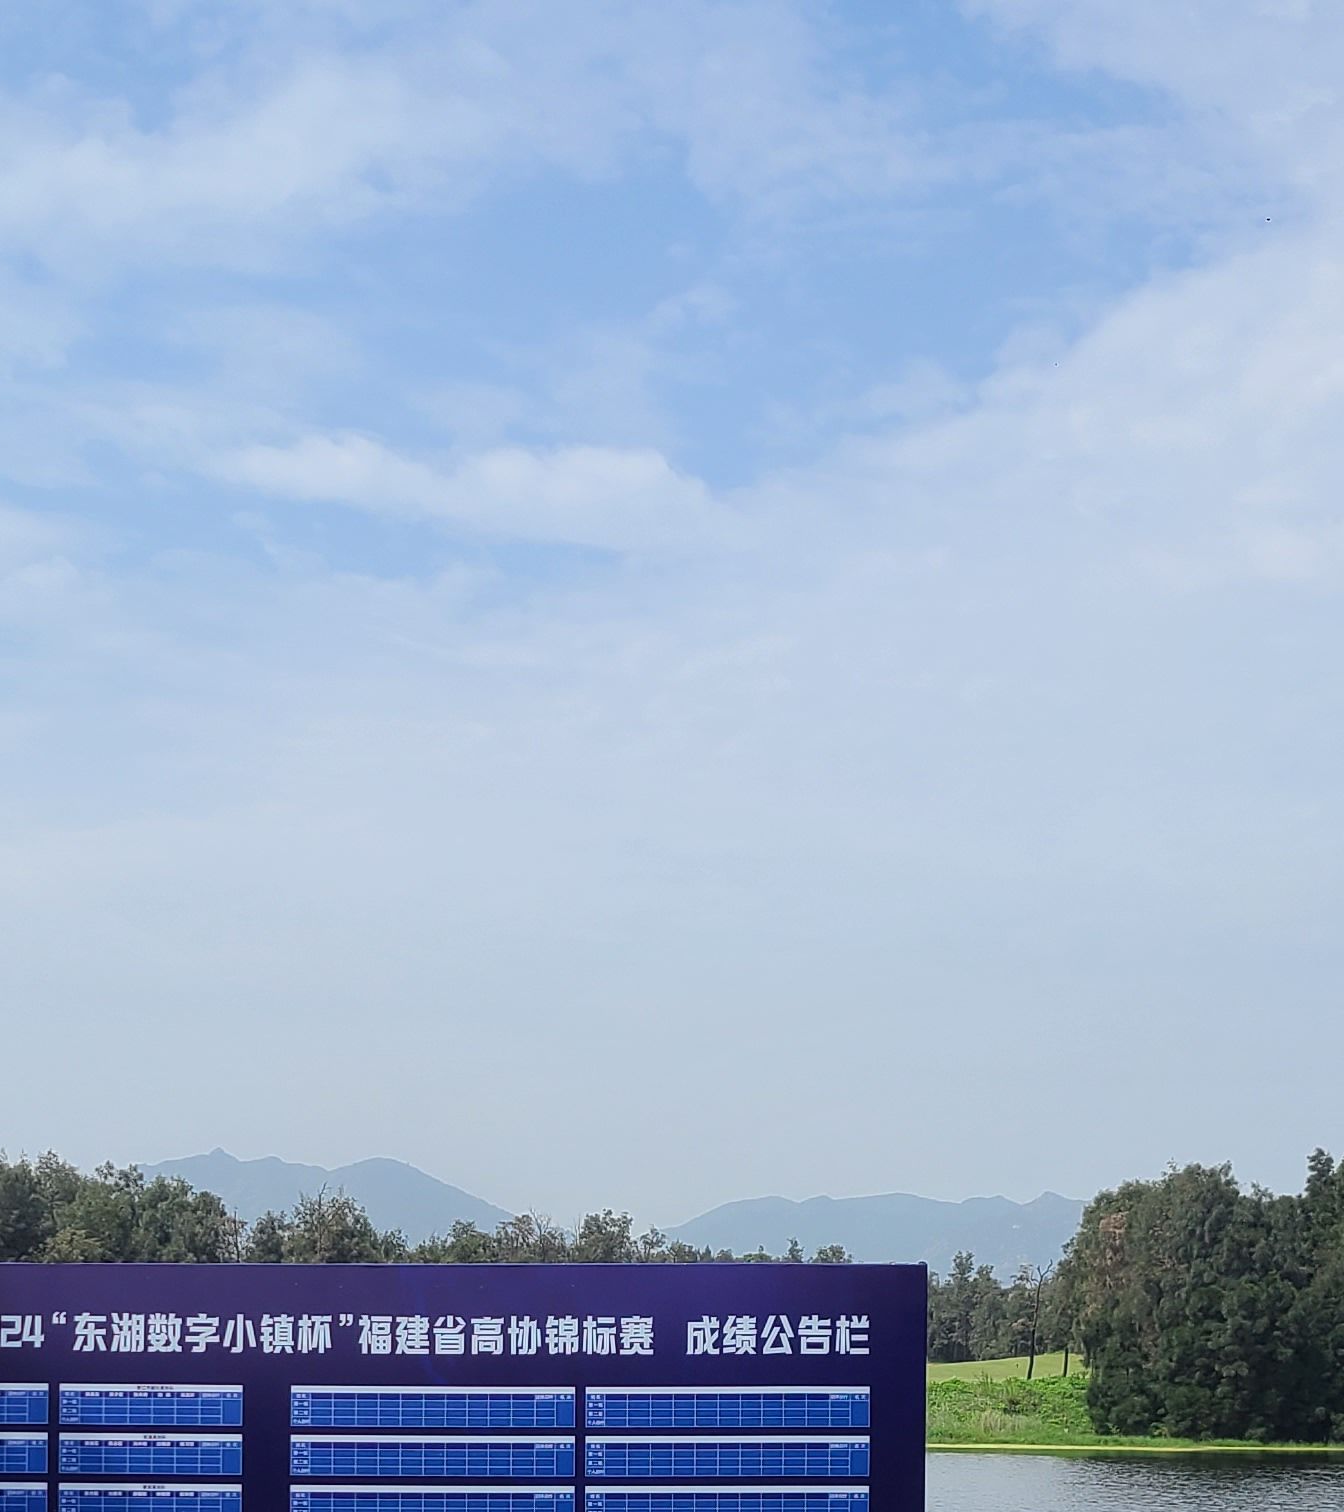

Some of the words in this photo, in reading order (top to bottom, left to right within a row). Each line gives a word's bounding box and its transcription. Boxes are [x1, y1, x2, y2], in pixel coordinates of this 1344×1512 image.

[686, 1315, 871, 1357] 成绩公告栏
